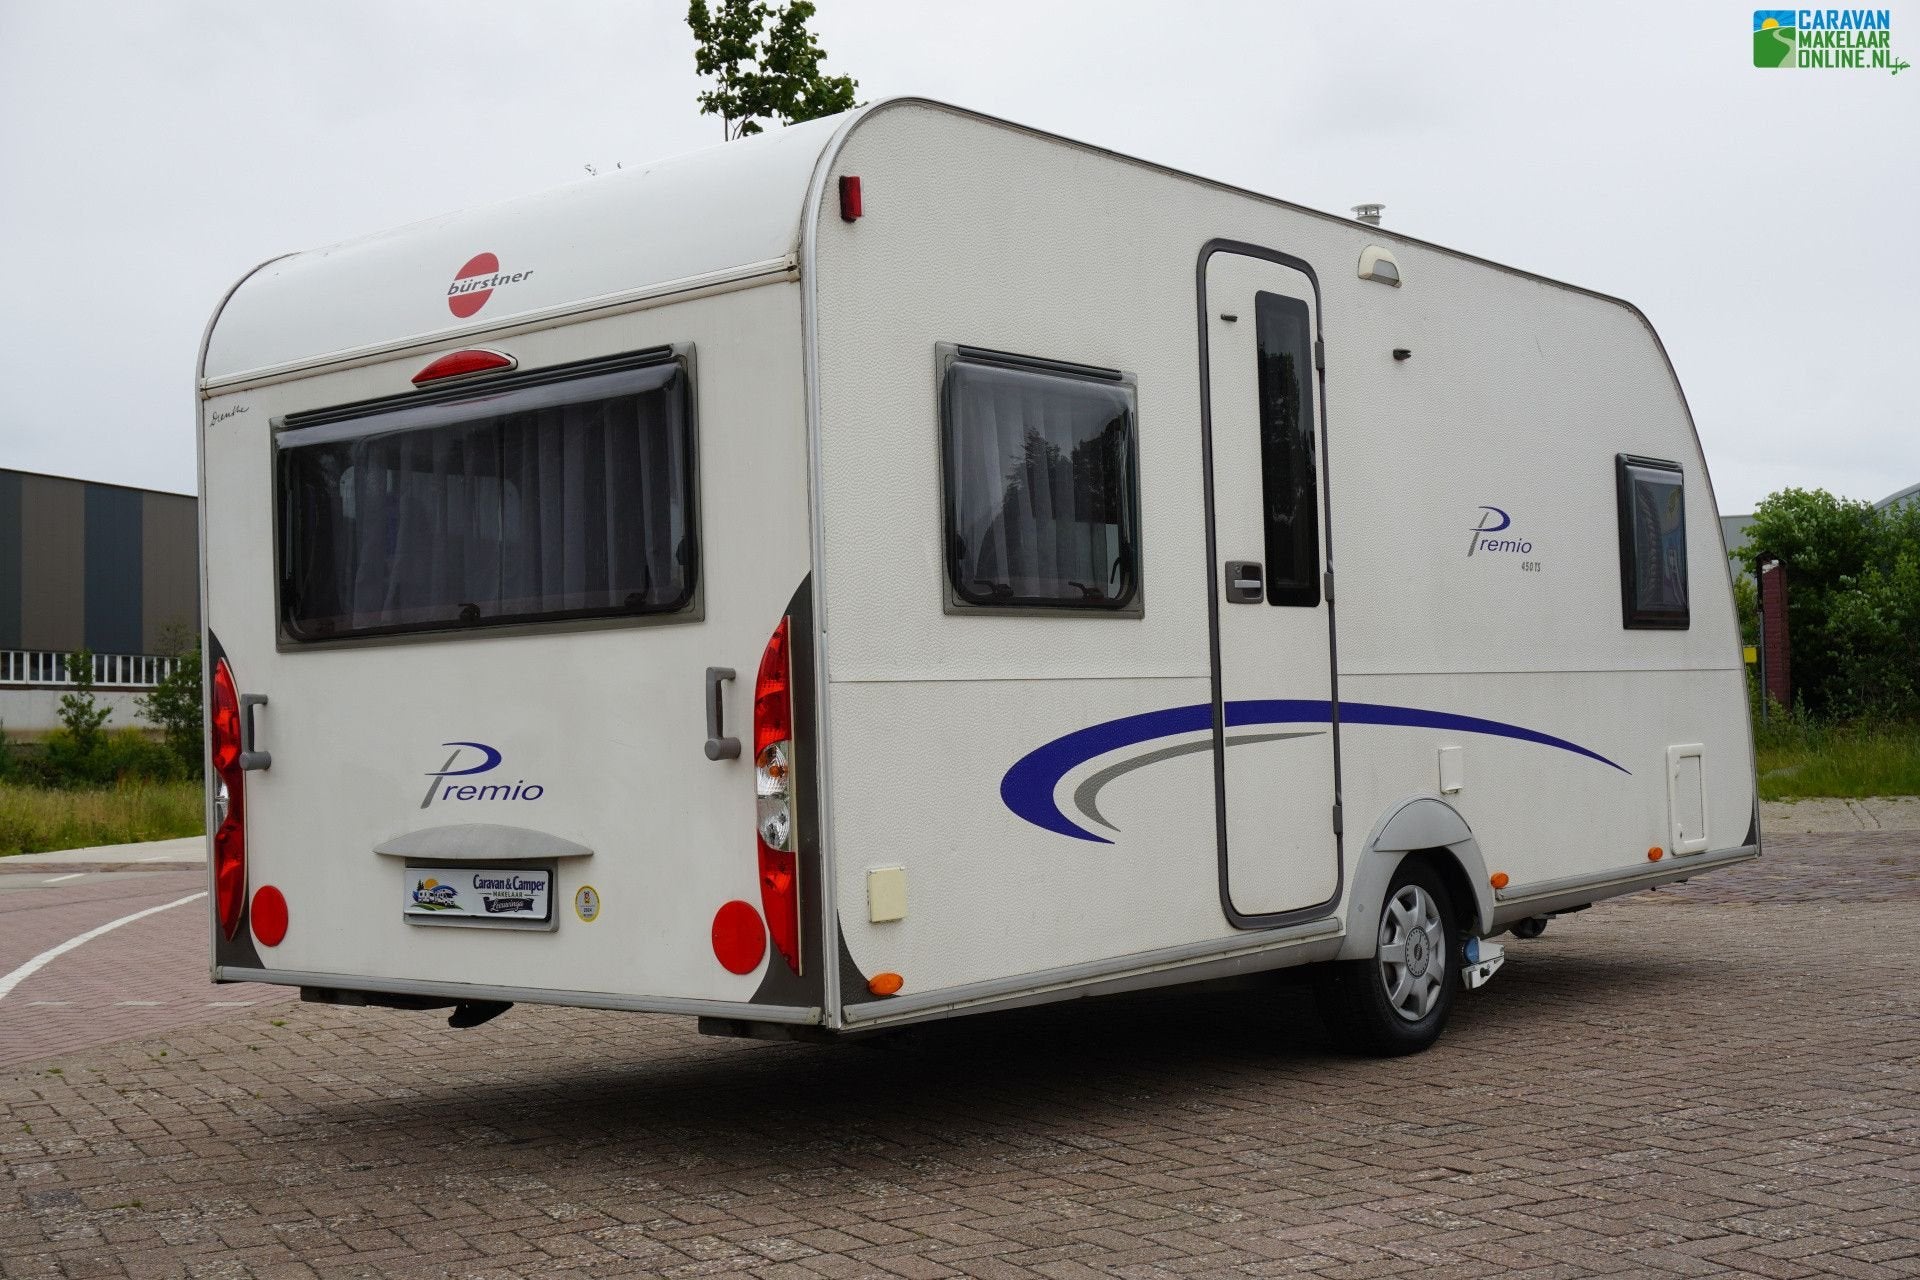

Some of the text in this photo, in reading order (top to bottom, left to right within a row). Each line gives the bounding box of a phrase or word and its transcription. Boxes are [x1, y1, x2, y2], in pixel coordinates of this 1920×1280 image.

[447, 270, 534, 296] bürstner
[1467, 506, 1532, 557] Premio
[420, 742, 544, 809] Premio
[473, 874, 505, 890] Caravan
[512, 875, 546, 894] Camper
